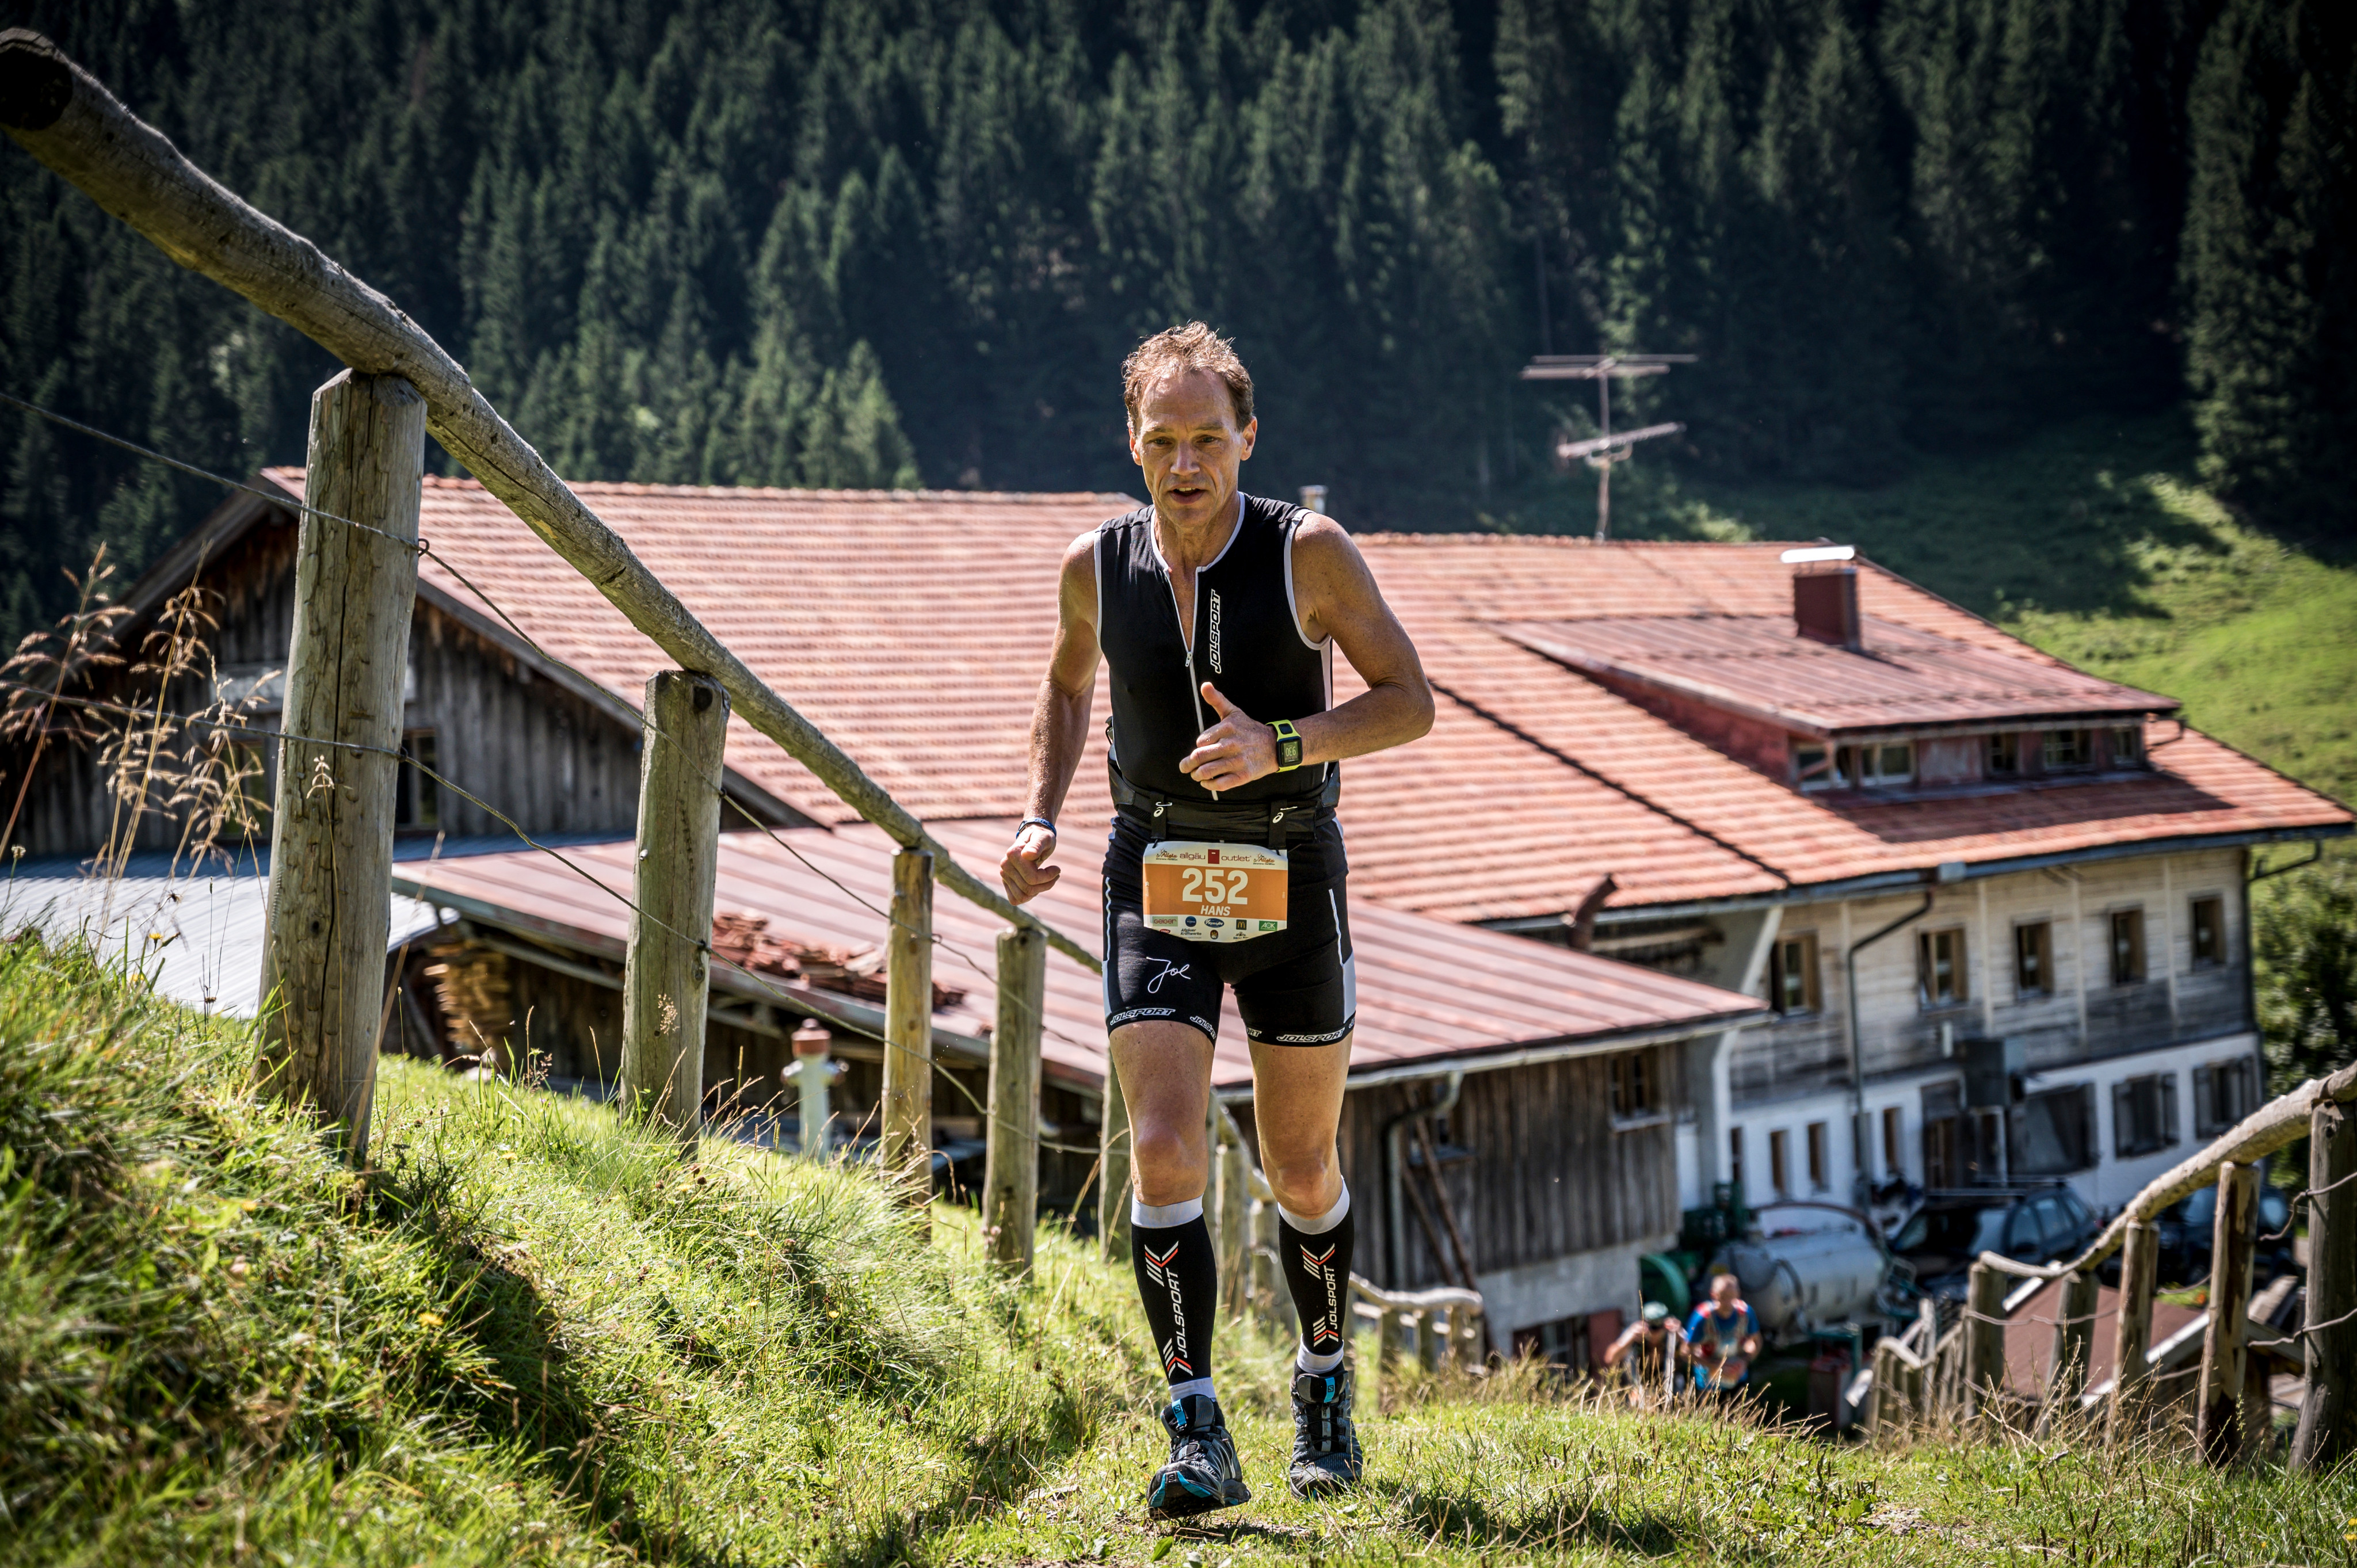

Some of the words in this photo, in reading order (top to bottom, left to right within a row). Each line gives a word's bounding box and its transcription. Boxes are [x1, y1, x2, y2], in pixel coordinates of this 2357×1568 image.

[1210, 589, 1221, 674] JOLSPORT
[1180, 852, 1206, 860] allgäu
[1182, 868, 1248, 905] 252
[1200, 905, 1230, 916] HANS
[1110, 1008, 1176, 1025] JOLSPORT
[1276, 1027, 1345, 1042] JOLSPORT
[1324, 1265, 1337, 1330] JOLSPORT
[1165, 1267, 1188, 1359] JOLSPORT
